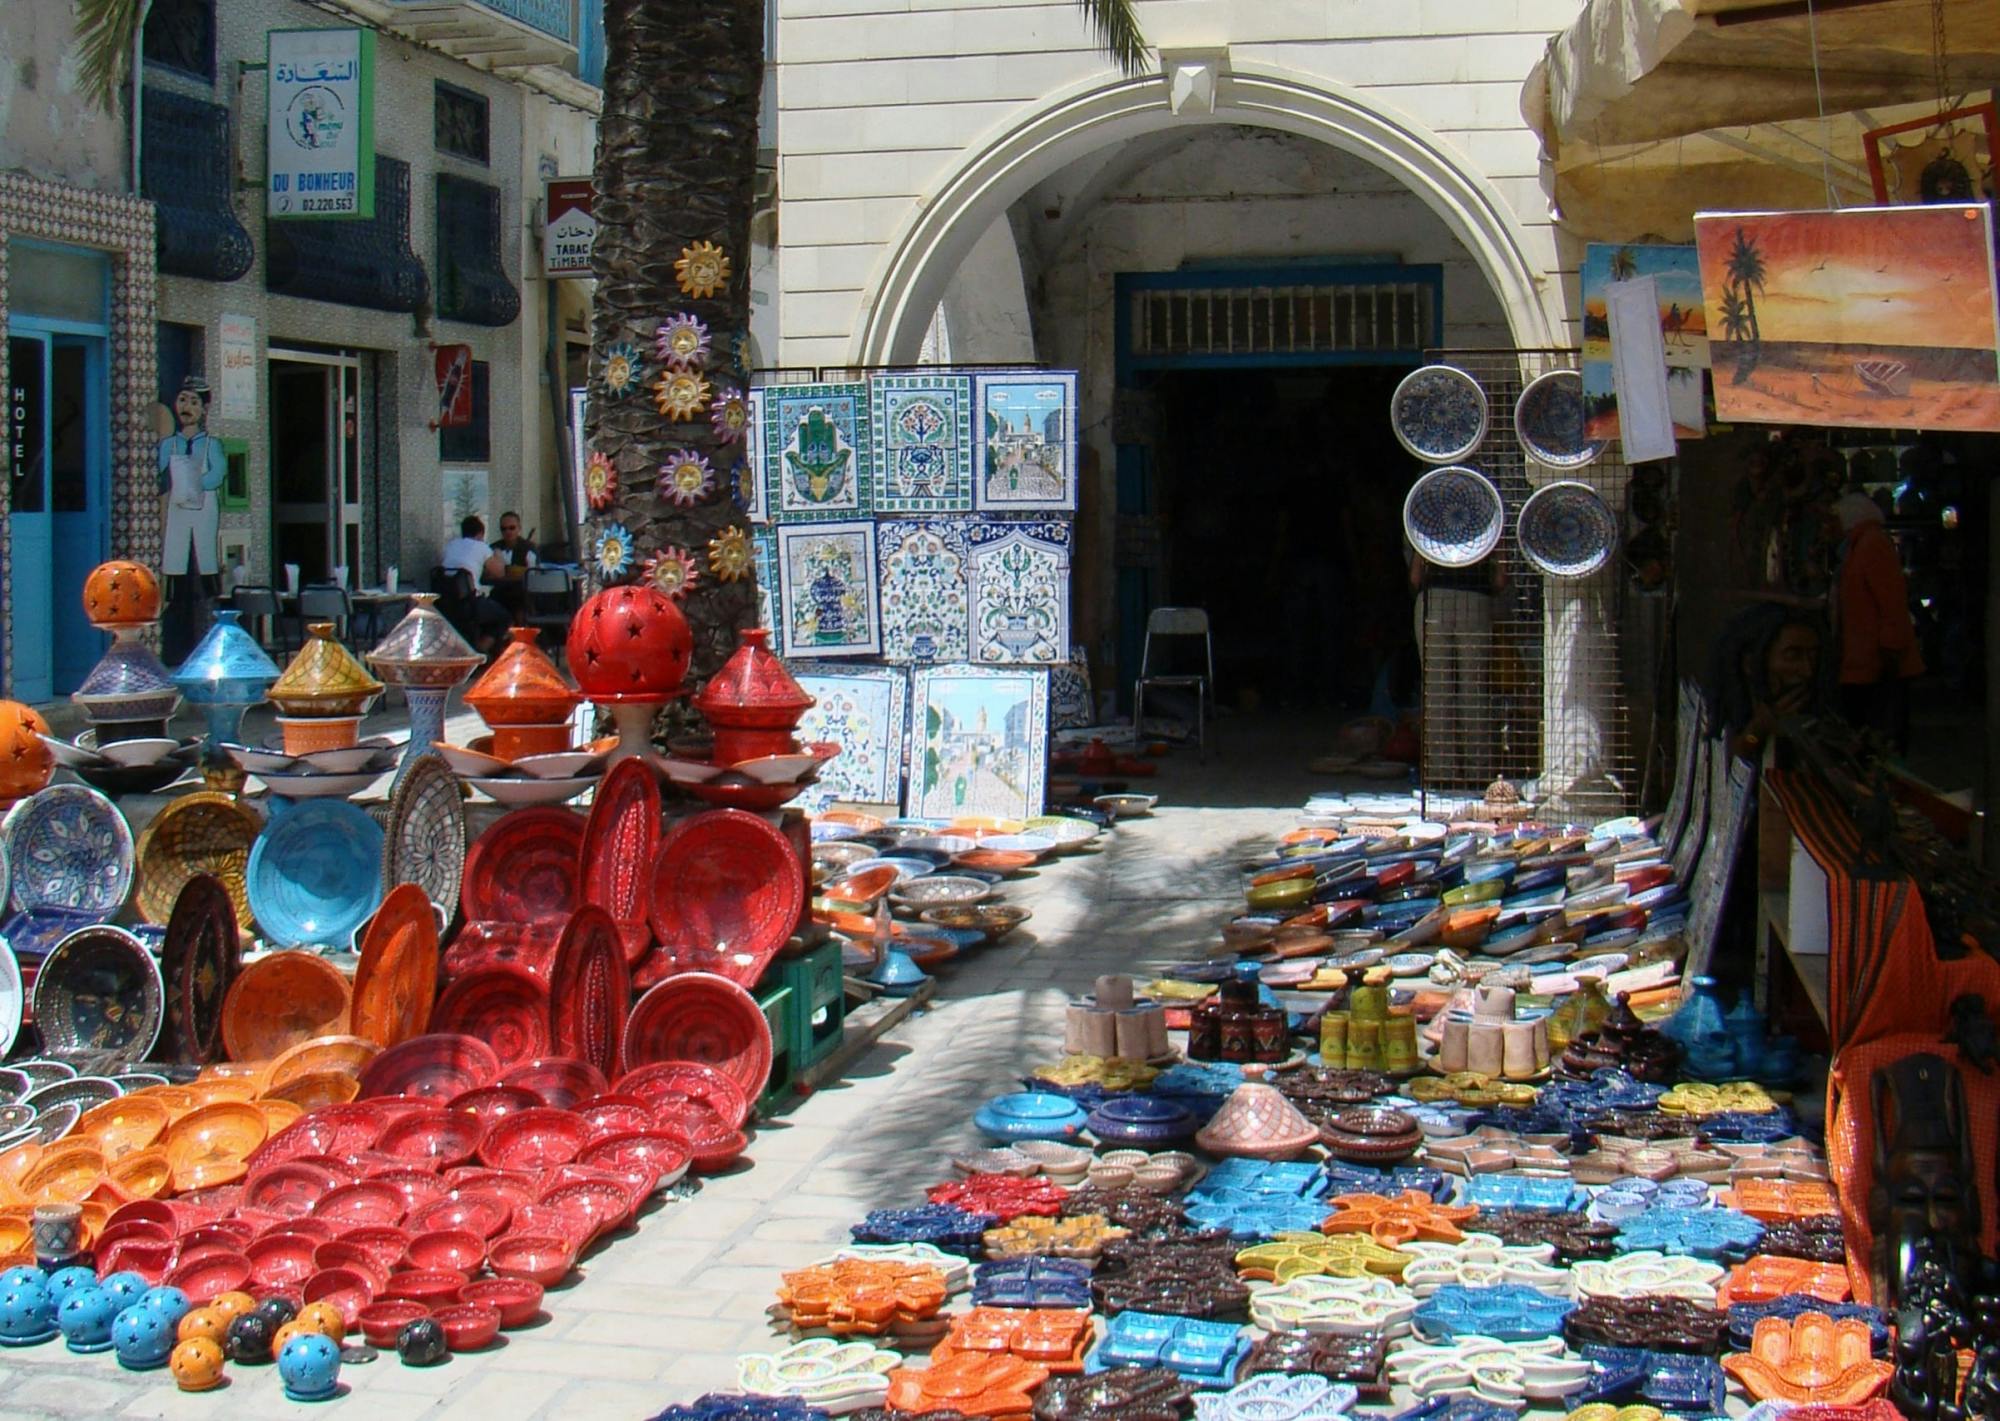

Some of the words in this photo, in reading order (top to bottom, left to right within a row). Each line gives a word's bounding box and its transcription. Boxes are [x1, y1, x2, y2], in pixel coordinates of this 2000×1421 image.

[273, 173, 289, 192] DU
[298, 172, 355, 191] BONHEUR
[556, 243, 589, 256] TABAC
[15, 387, 25, 477] HOTEL
